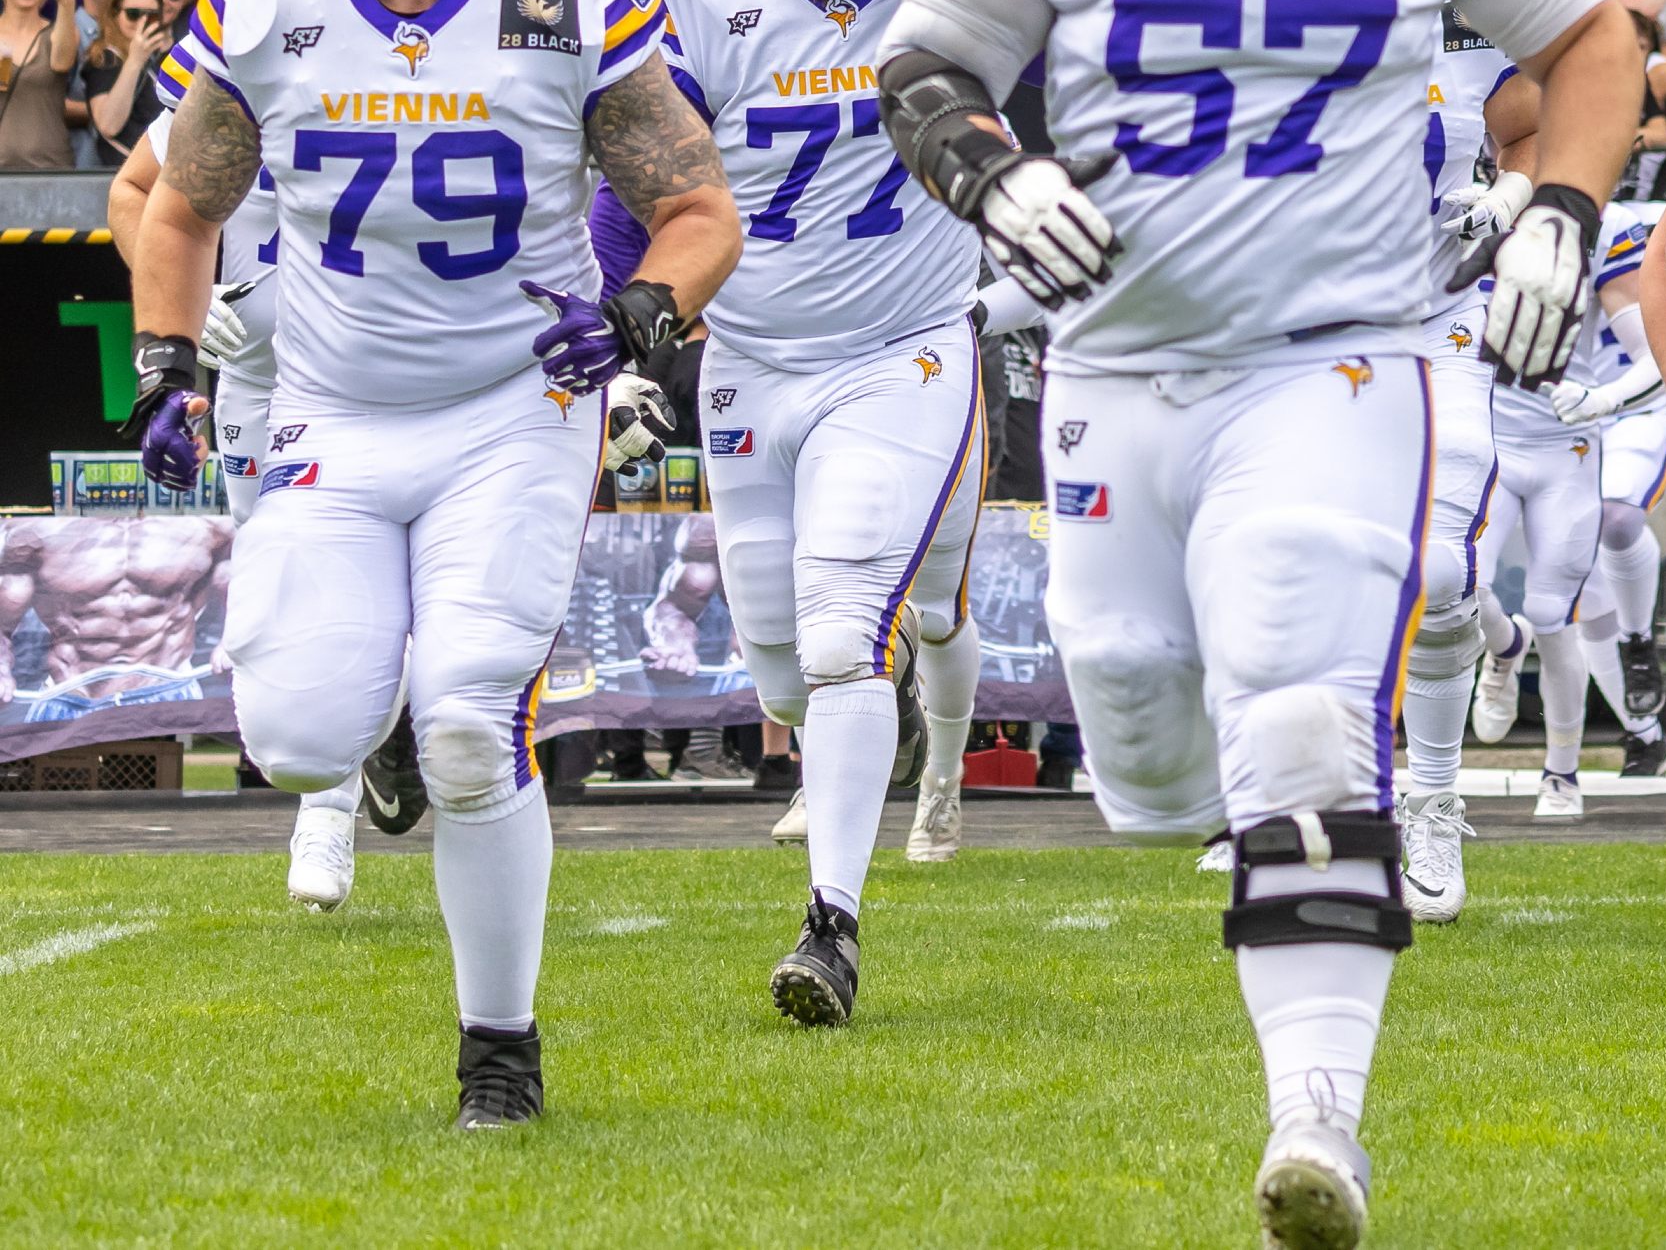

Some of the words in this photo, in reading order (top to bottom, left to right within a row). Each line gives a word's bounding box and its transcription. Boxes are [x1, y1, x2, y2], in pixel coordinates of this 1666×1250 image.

[501, 33, 522, 47] 28
[528, 33, 579, 53] BLACK
[1445, 40, 1460, 51] 28
[772, 65, 881, 97] VIENN
[320, 92, 492, 122] VIENNA
[745, 97, 911, 243] 77
[293, 129, 528, 281] 79
